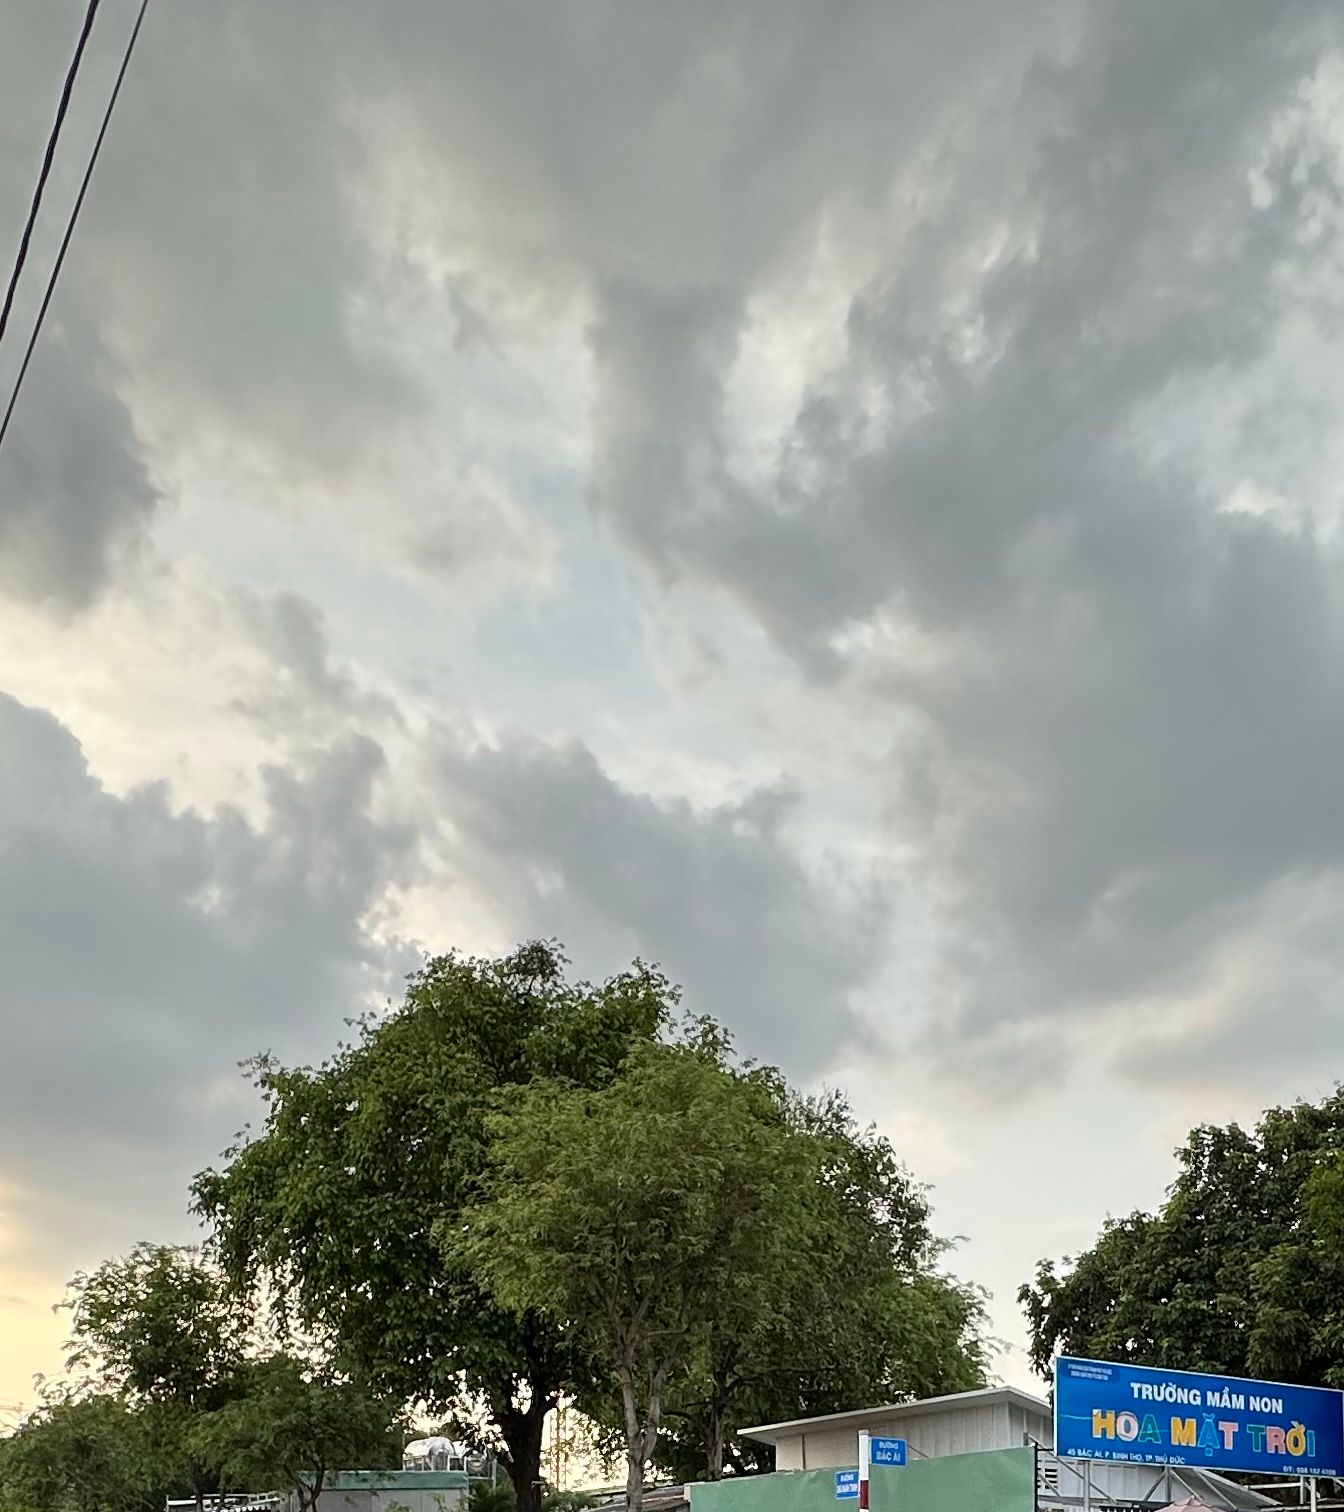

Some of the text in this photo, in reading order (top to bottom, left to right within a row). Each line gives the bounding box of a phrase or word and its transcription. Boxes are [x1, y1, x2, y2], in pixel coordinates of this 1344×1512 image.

[1130, 1382, 1283, 1414] TRƯỜNG MẦM NON
[1092, 1408, 1316, 1457] HOA MẶT TRỜI
[876, 1450, 892, 1461] BÁC
